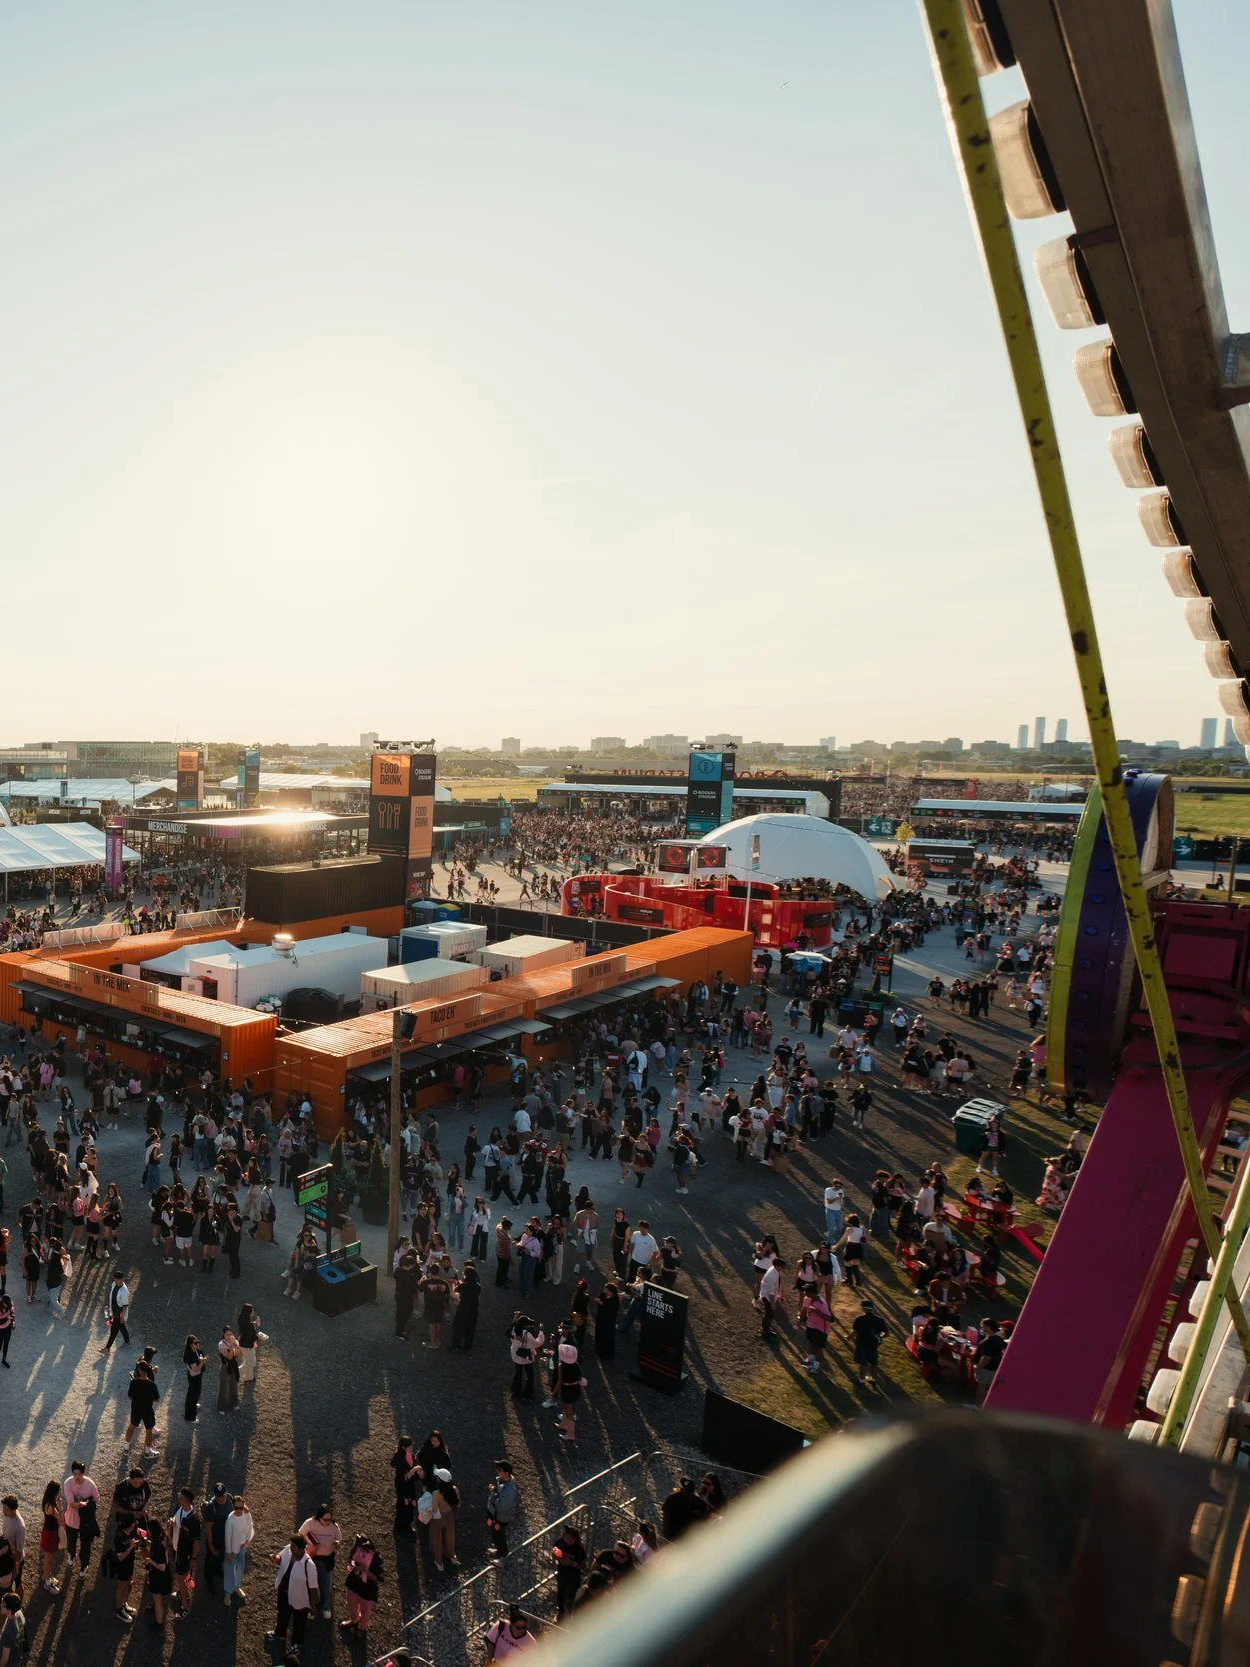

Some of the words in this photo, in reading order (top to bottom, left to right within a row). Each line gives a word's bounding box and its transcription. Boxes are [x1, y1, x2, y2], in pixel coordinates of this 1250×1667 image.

[380, 763, 399, 774] FOOD
[380, 774, 402, 785] DRINK
[414, 806, 428, 817] FOOD
[148, 820, 188, 834] MERCHANDISE
[414, 817, 429, 828] DRINK
[93, 972, 101, 984] IN
[102, 975, 115, 989] THE
[116, 979, 130, 993] MIX
[430, 1009, 446, 1024] TACO
[647, 1289, 664, 1300] LINE
[646, 1298, 674, 1314] STARTS
[646, 1305, 665, 1319] HERE
